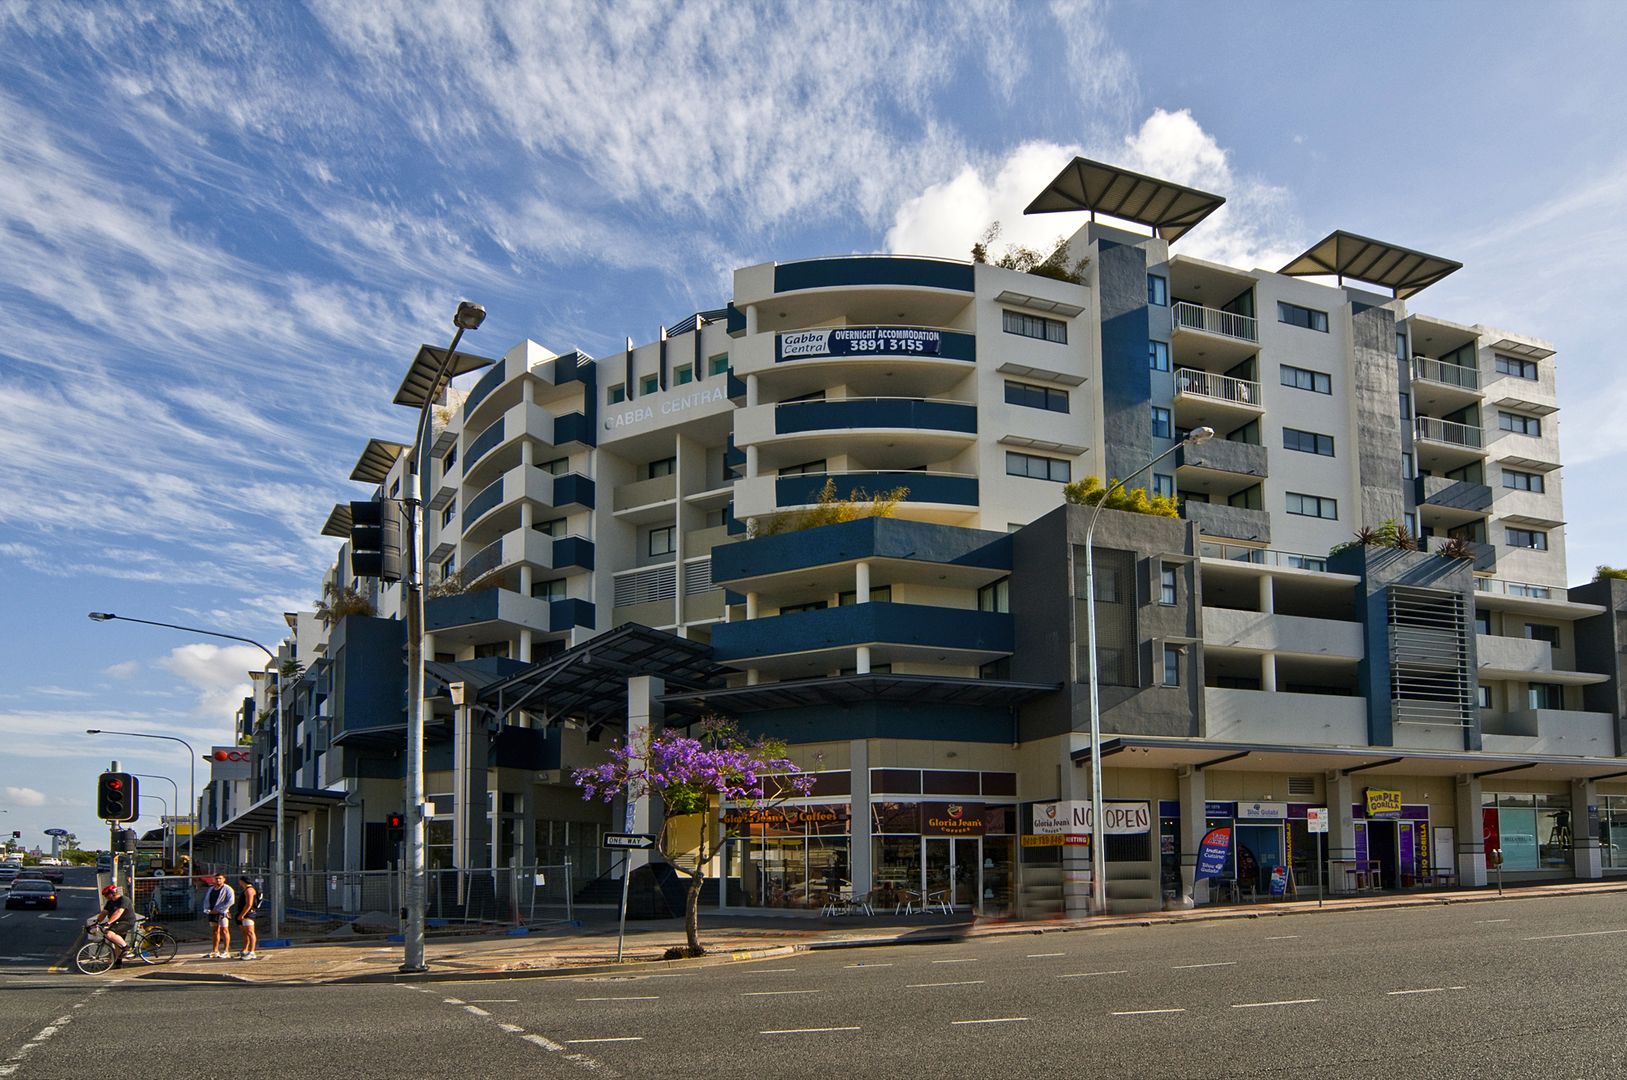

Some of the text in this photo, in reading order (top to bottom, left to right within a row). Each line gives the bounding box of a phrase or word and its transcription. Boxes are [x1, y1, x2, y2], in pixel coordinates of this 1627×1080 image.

[784, 333, 823, 345] Gabba
[835, 330, 940, 341] OVERNIGHT ACCOMMODATION
[784, 342, 826, 354] Central
[850, 340, 924, 351] 3891 3155
[604, 406, 654, 430] GABBA
[1369, 792, 1400, 802] PURPLE
[1370, 800, 1400, 811] GORILLA
[928, 818, 982, 827] Gloria Jean's
[1034, 818, 1053, 828] Gloria
[1106, 808, 1148, 828] OPEN
